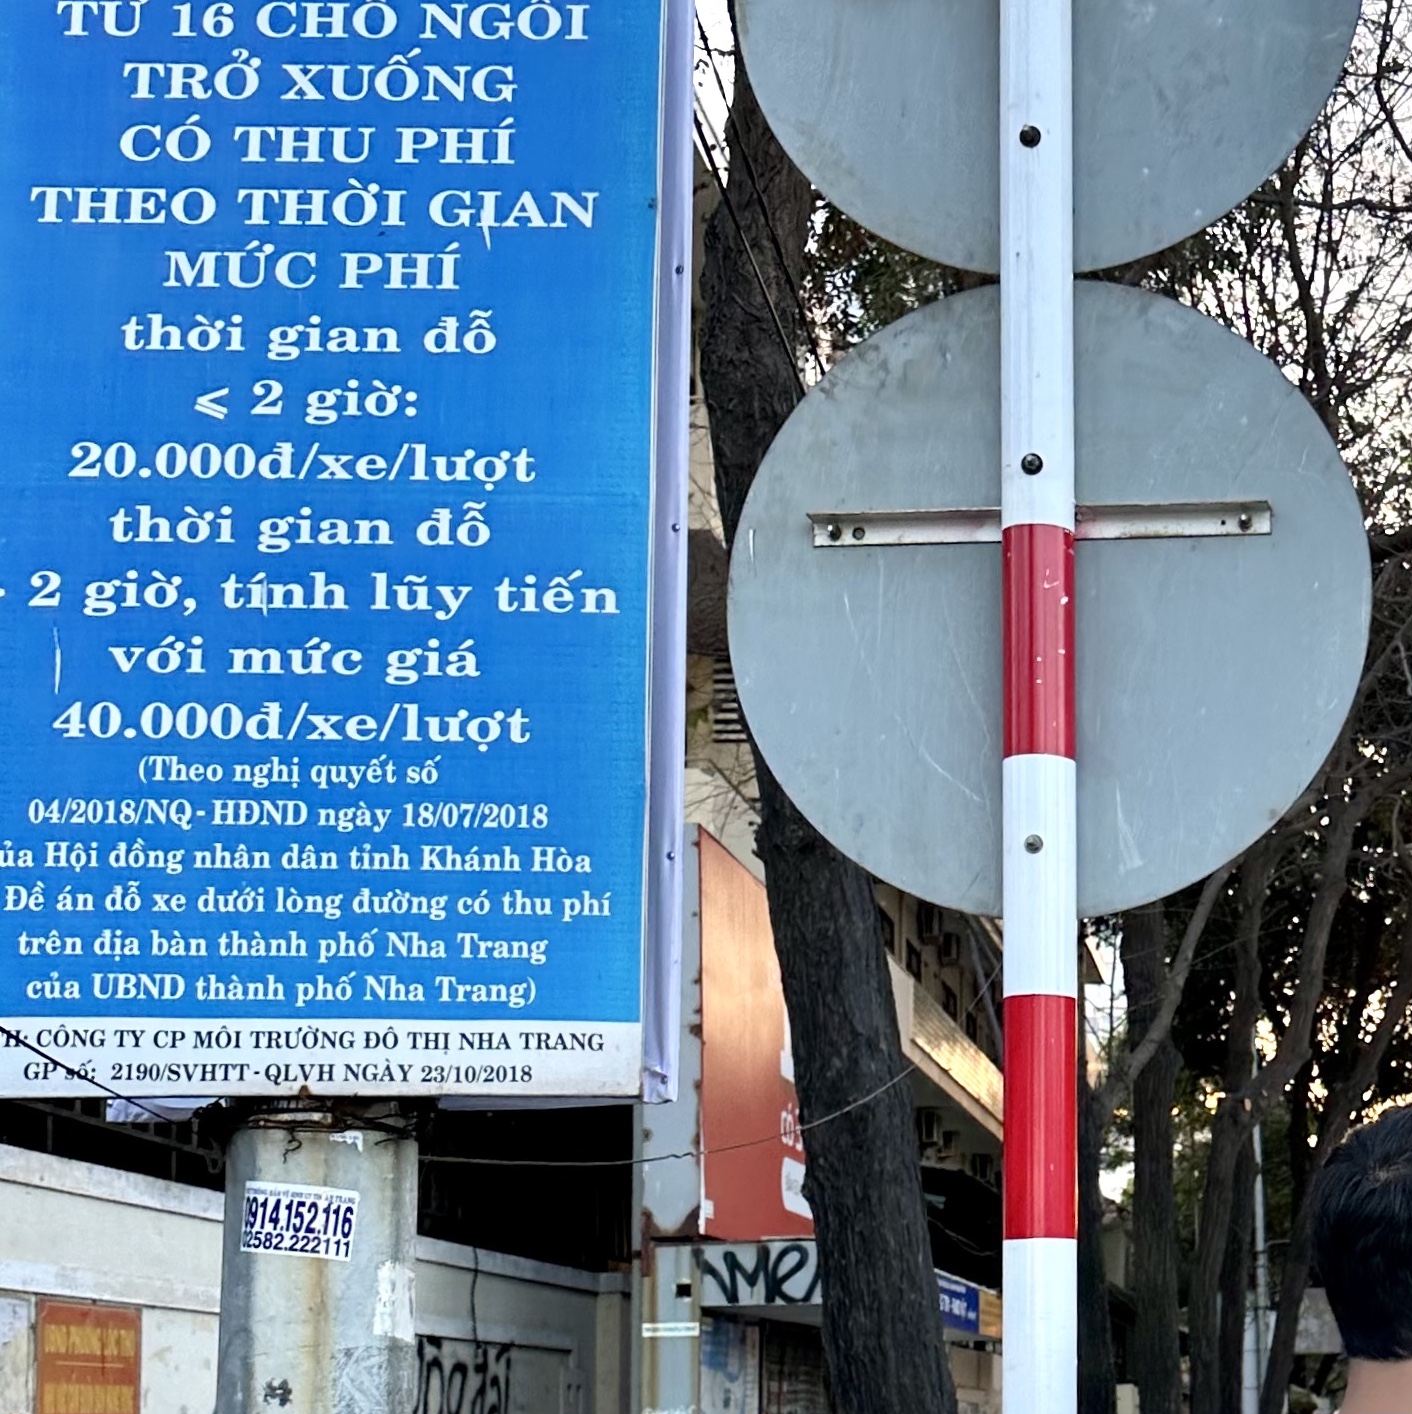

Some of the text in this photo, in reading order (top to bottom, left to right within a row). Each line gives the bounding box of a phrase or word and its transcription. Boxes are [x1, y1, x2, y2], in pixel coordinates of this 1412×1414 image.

[173, 3, 233, 37] 16
[124, 48, 517, 101] TRỞ XUỐNG
[120, 115, 514, 163] CÓ THU PHÍ
[31, 179, 599, 229] THEO THỜI GIAN
[164, 241, 460, 290] MỨC PHÍ
[122, 310, 496, 360] thời gian đỗ
[252, 380, 282, 414] 2
[306, 380, 417, 424] giờ:
[69, 442, 535, 490] 20.000đ/xe/lượt
[110, 502, 490, 552] thời gian đỗ
[29, 569, 619, 620] 2 giờ, tính lũy tiến
[109, 636, 479, 684] với mức giá
[53, 702, 529, 751] 40.000đ/xe/lượt
[139, 755, 440, 788] (Theo nghị quyết số
[319, 802, 390, 831] ngày
[404, 803, 547, 827] 18/07/2018
[45, 842, 97, 872] Hội
[109, 839, 184, 874] đồng
[194, 843, 269, 868] nhân
[282, 844, 337, 869] dân
[350, 845, 408, 869] tỉnh
[422, 846, 520, 871] Khánh
[532, 847, 591, 872] Hòa
[5, 882, 610, 921] Đề án đỗ xe dưới lòng đường có thu phí
[19, 928, 547, 964] trên địa bàn thành phố Nha Trang
[27, 972, 535, 1007] của UBND thành phố Nha Trang)
[36, 1024, 106, 1048] CÔNG
[115, 1030, 144, 1047] TY
[154, 1031, 185, 1048] CP
[194, 1026, 240, 1048] MÔI
[251, 1027, 354, 1049] TRƯỜNG
[365, 1027, 398, 1049] ĐÔ
[408, 1032, 449, 1053] THỊ
[460, 1033, 510, 1049] NHA
[520, 1033, 603, 1050] TRANG
[23, 1062, 57, 1081] GP
[344, 1059, 412, 1082] NGÀY
[421, 1064, 532, 1083] 23/10/2018
[245, 1196, 354, 1239] 0914.152.116
[243, 1231, 351, 1258] 02582.222111
